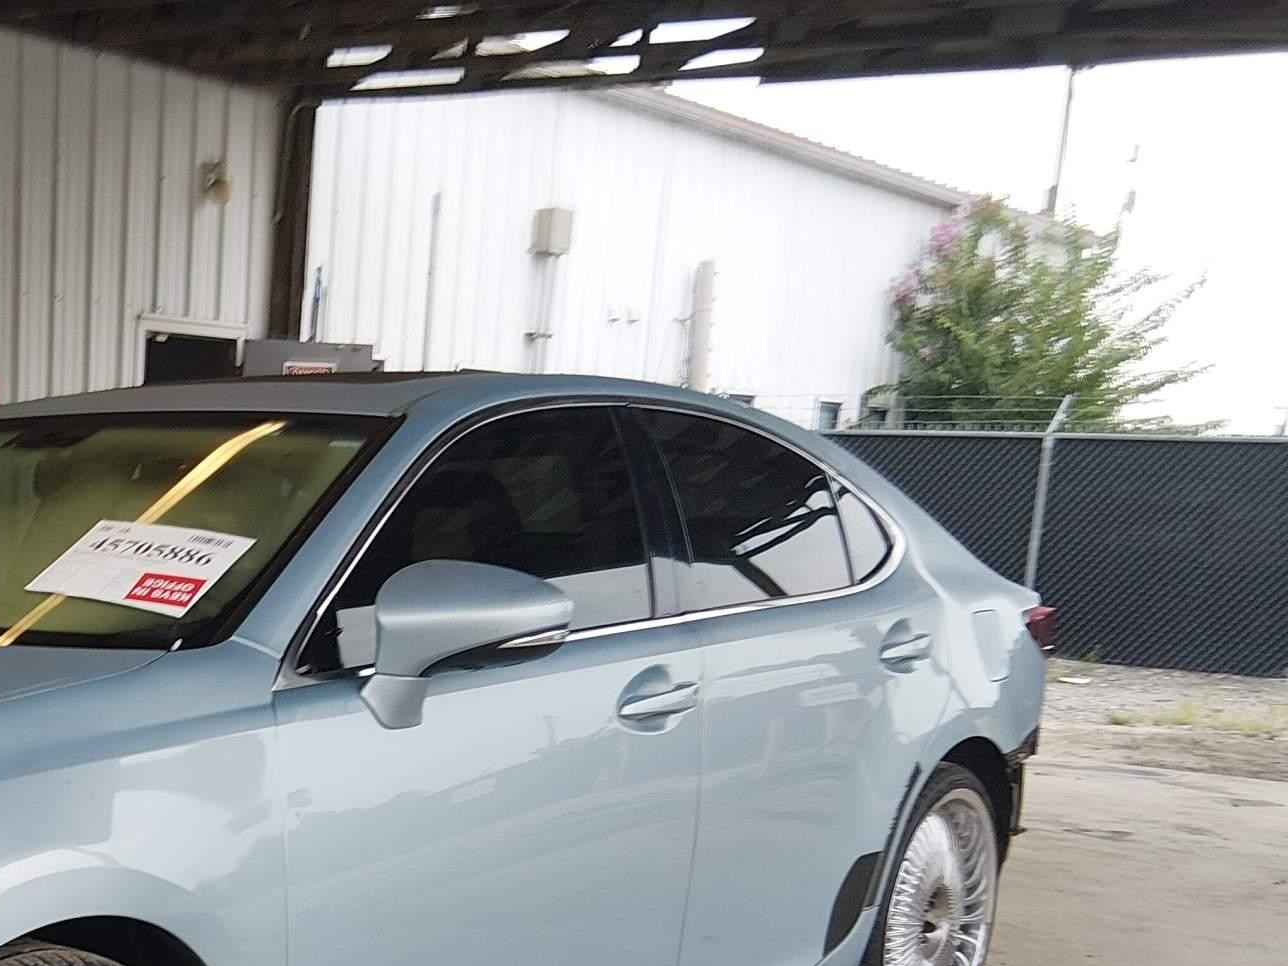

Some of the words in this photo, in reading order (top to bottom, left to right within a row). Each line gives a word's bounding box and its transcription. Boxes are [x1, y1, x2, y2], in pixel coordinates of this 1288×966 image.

[89, 538, 215, 565] 45705886
[131, 587, 151, 597] IN
[143, 578, 195, 592] OFFICE
[151, 589, 193, 603] KEYS
